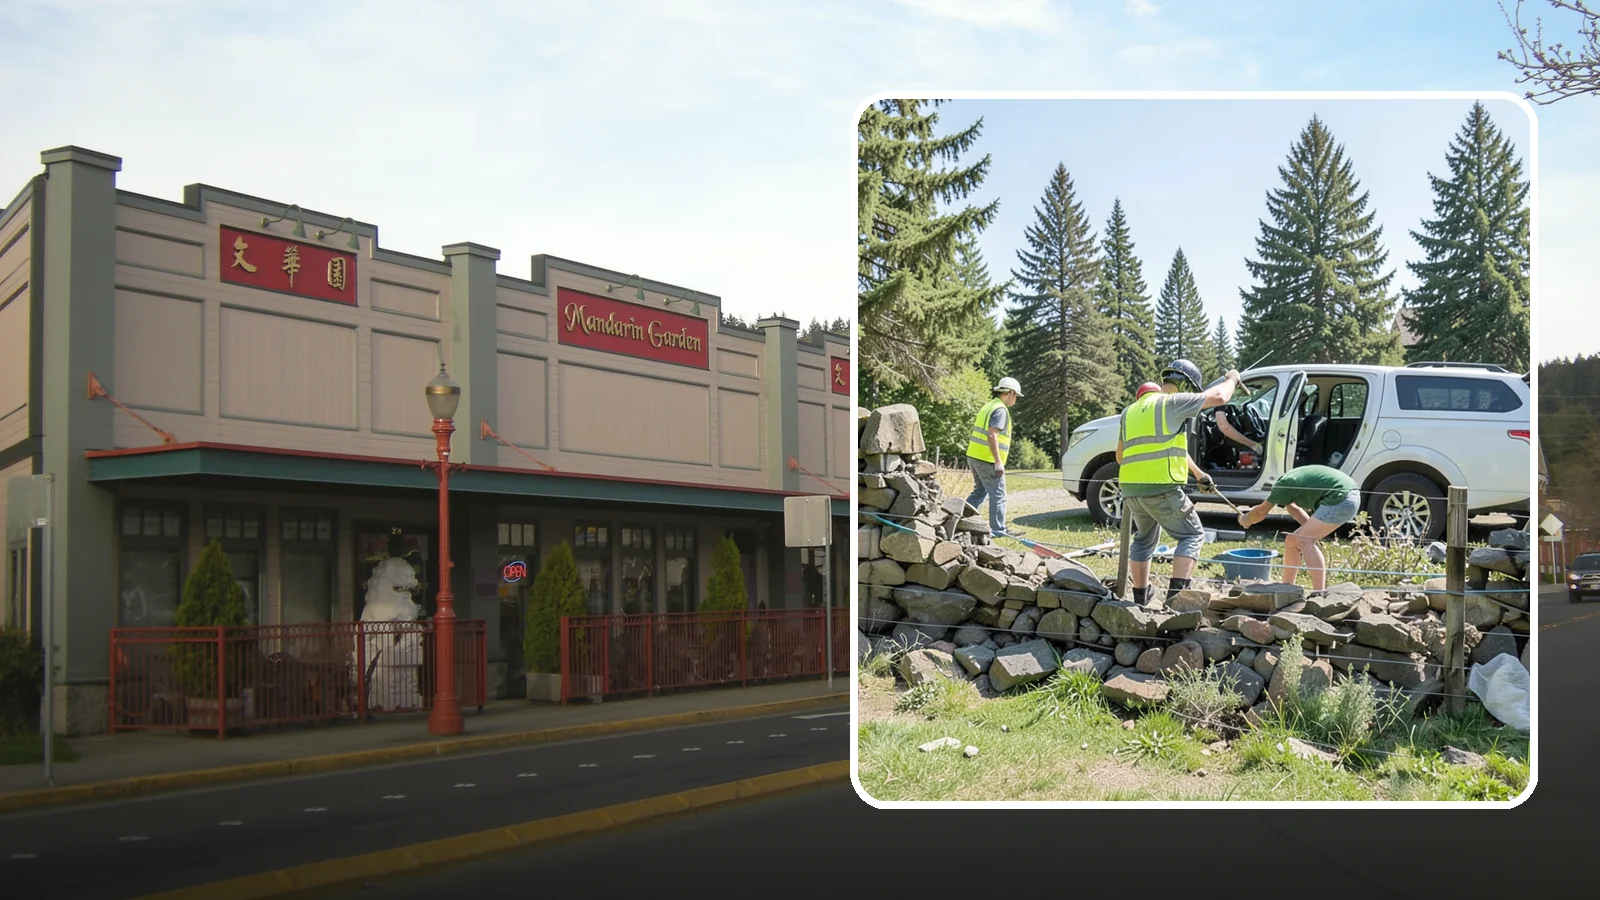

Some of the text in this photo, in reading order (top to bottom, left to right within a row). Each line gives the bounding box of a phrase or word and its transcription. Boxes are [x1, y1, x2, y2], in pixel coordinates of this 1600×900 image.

[231, 236, 346, 291] 文華園
[564, 302, 701, 352] Mandarin Garden
[834, 363, 846, 386] 文
[503, 565, 527, 579] OPEN
